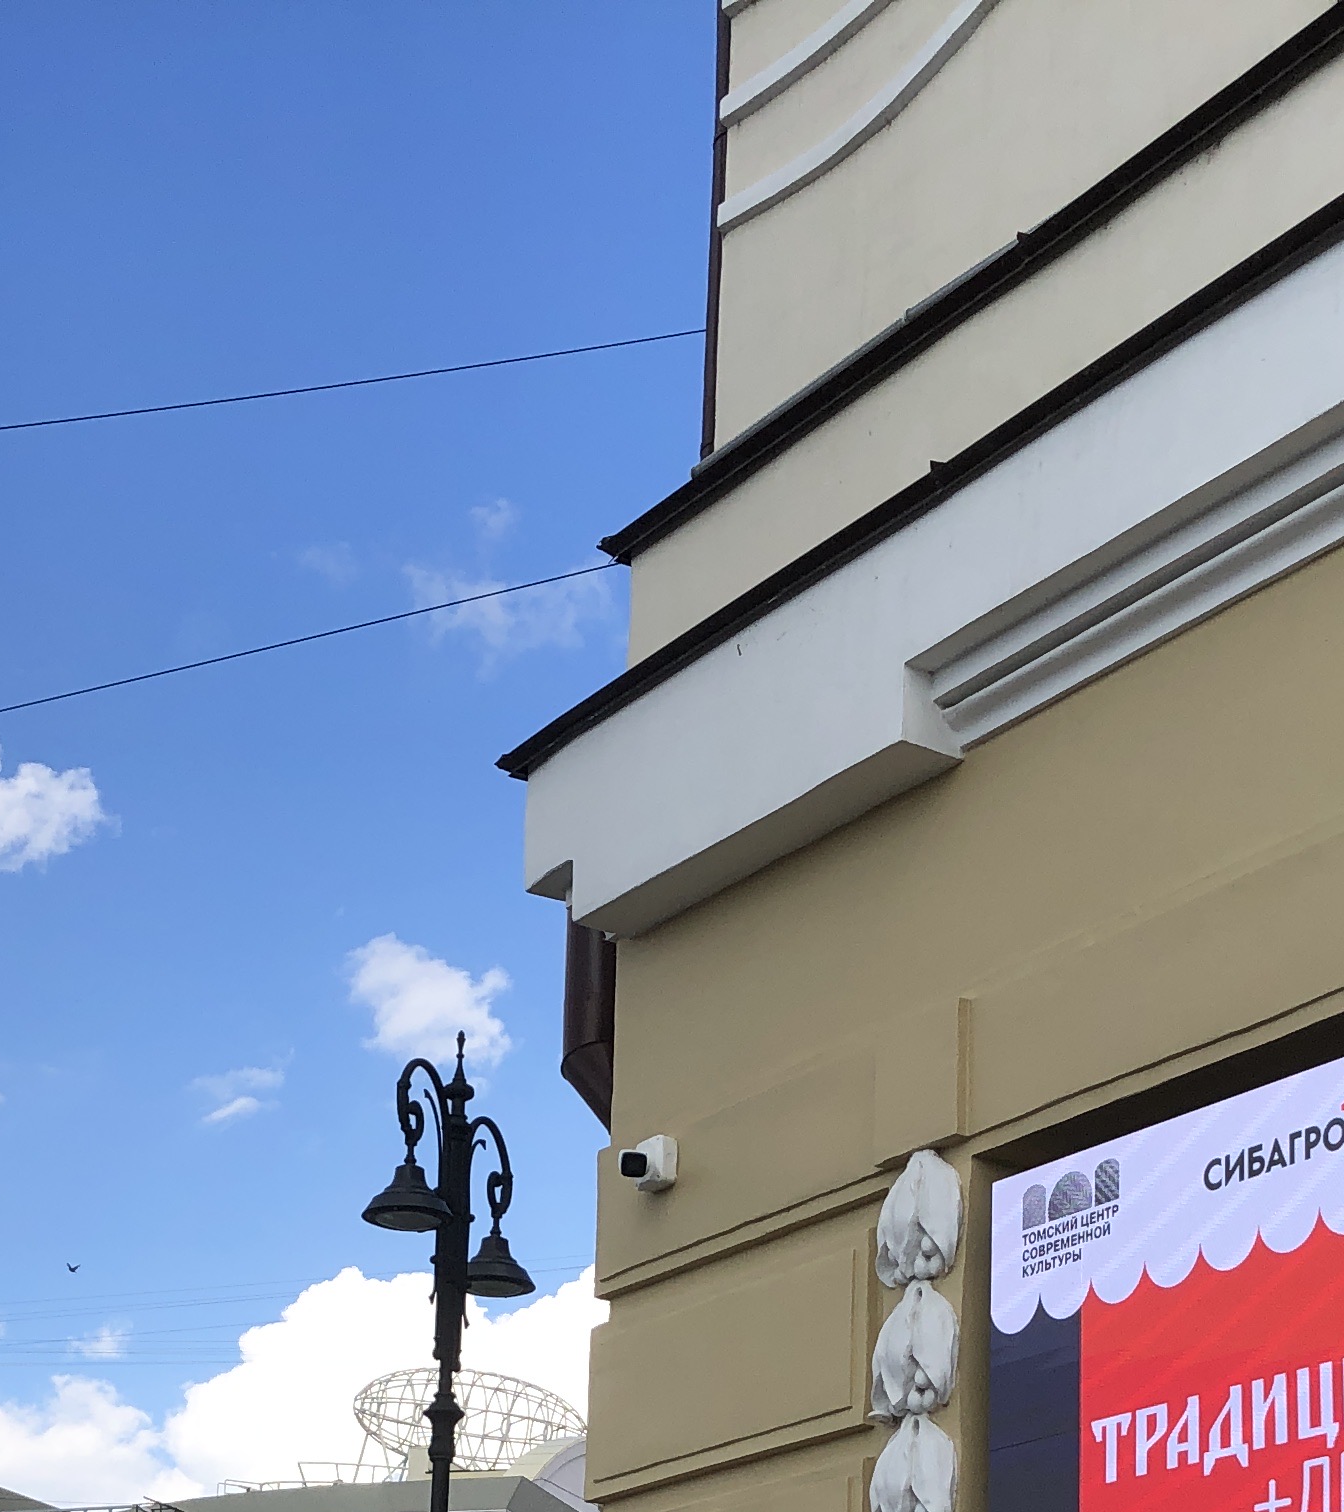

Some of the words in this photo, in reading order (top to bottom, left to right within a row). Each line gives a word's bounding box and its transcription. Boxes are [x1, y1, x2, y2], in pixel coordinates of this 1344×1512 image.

[1022, 1216, 1078, 1246] ТОМСКИЙ
[1081, 1204, 1119, 1228] ЦЕНТР
[1022, 1221, 1111, 1262] СОВРЕМЕННОЙ
[1022, 1248, 1082, 1278] КУЛЬТУРЫ
